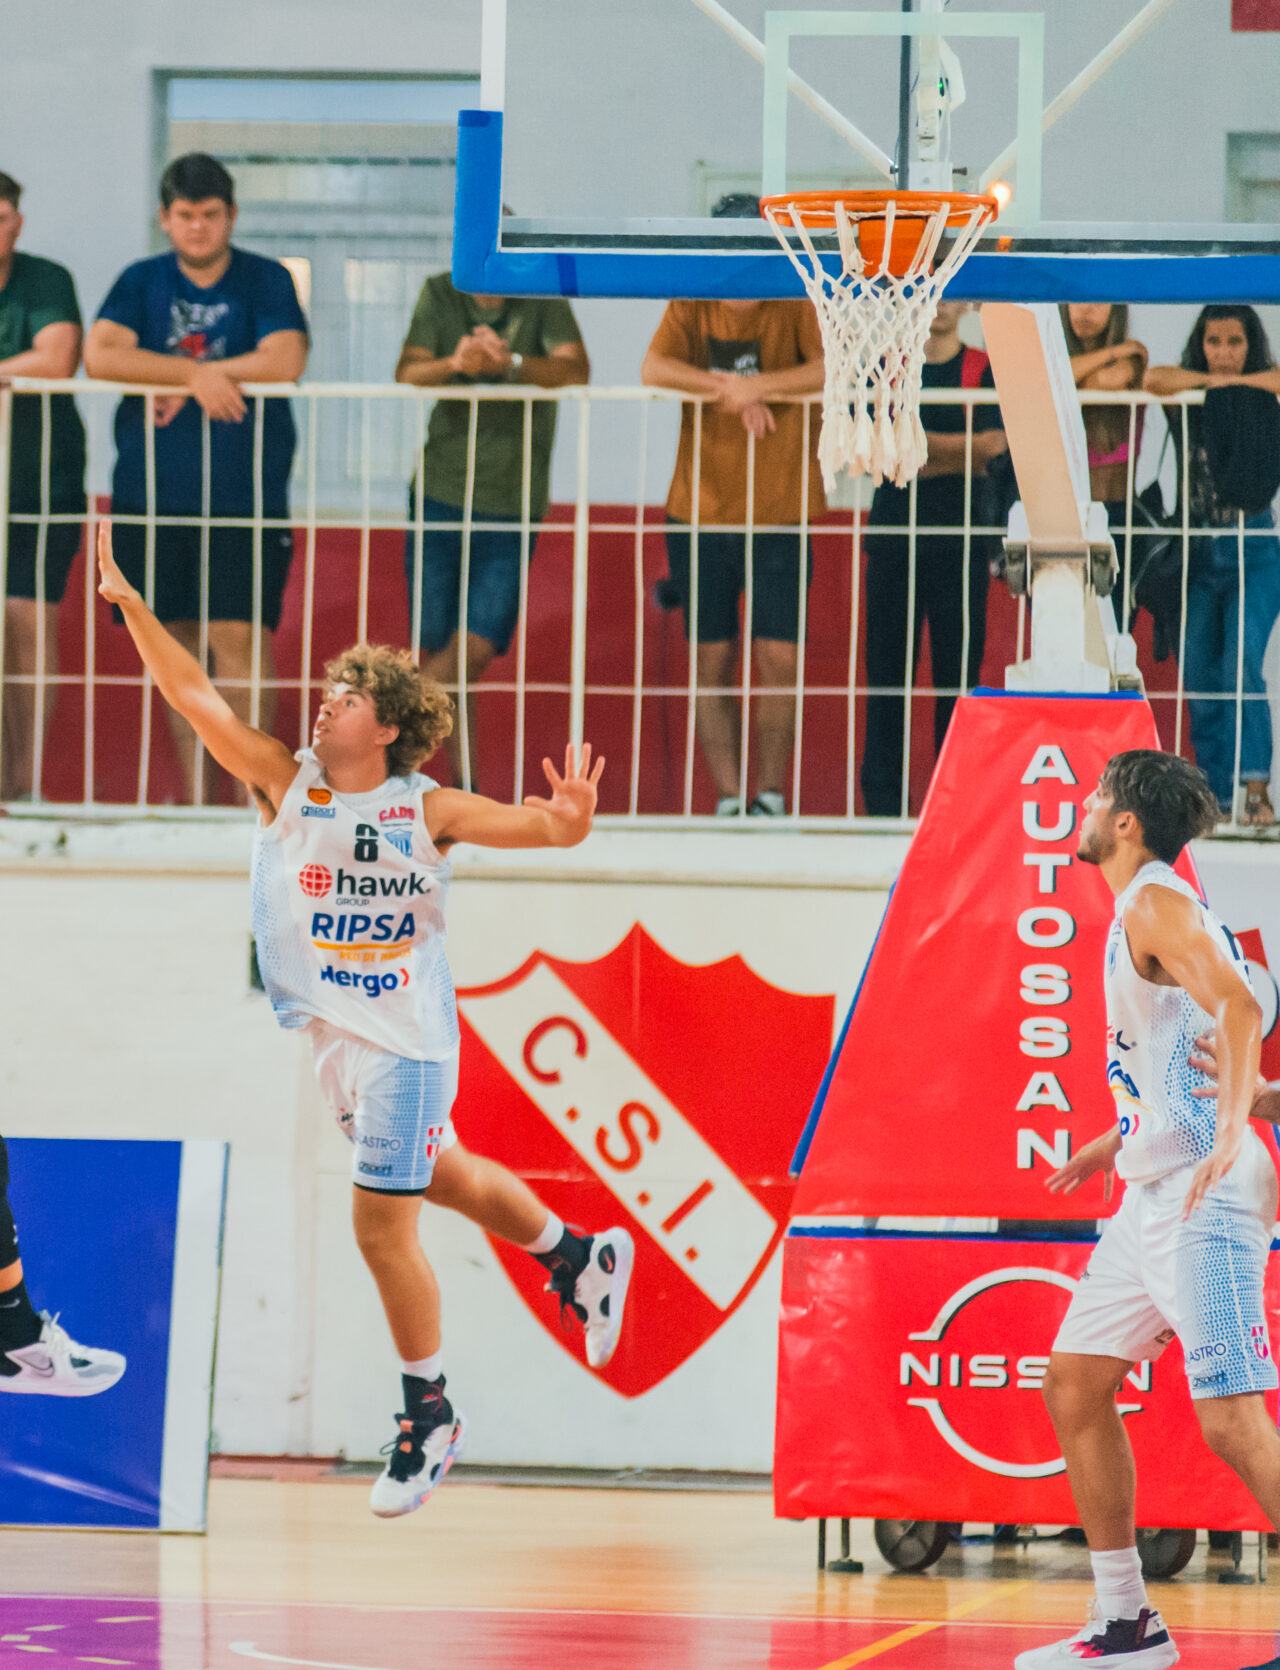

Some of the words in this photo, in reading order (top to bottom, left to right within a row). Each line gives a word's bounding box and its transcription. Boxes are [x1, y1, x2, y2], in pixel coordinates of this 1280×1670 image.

[311, 912, 417, 943] RIPSA
[1016, 744, 1078, 1169] AUTOSSAN
[899, 1352, 1153, 1393] NISSN
